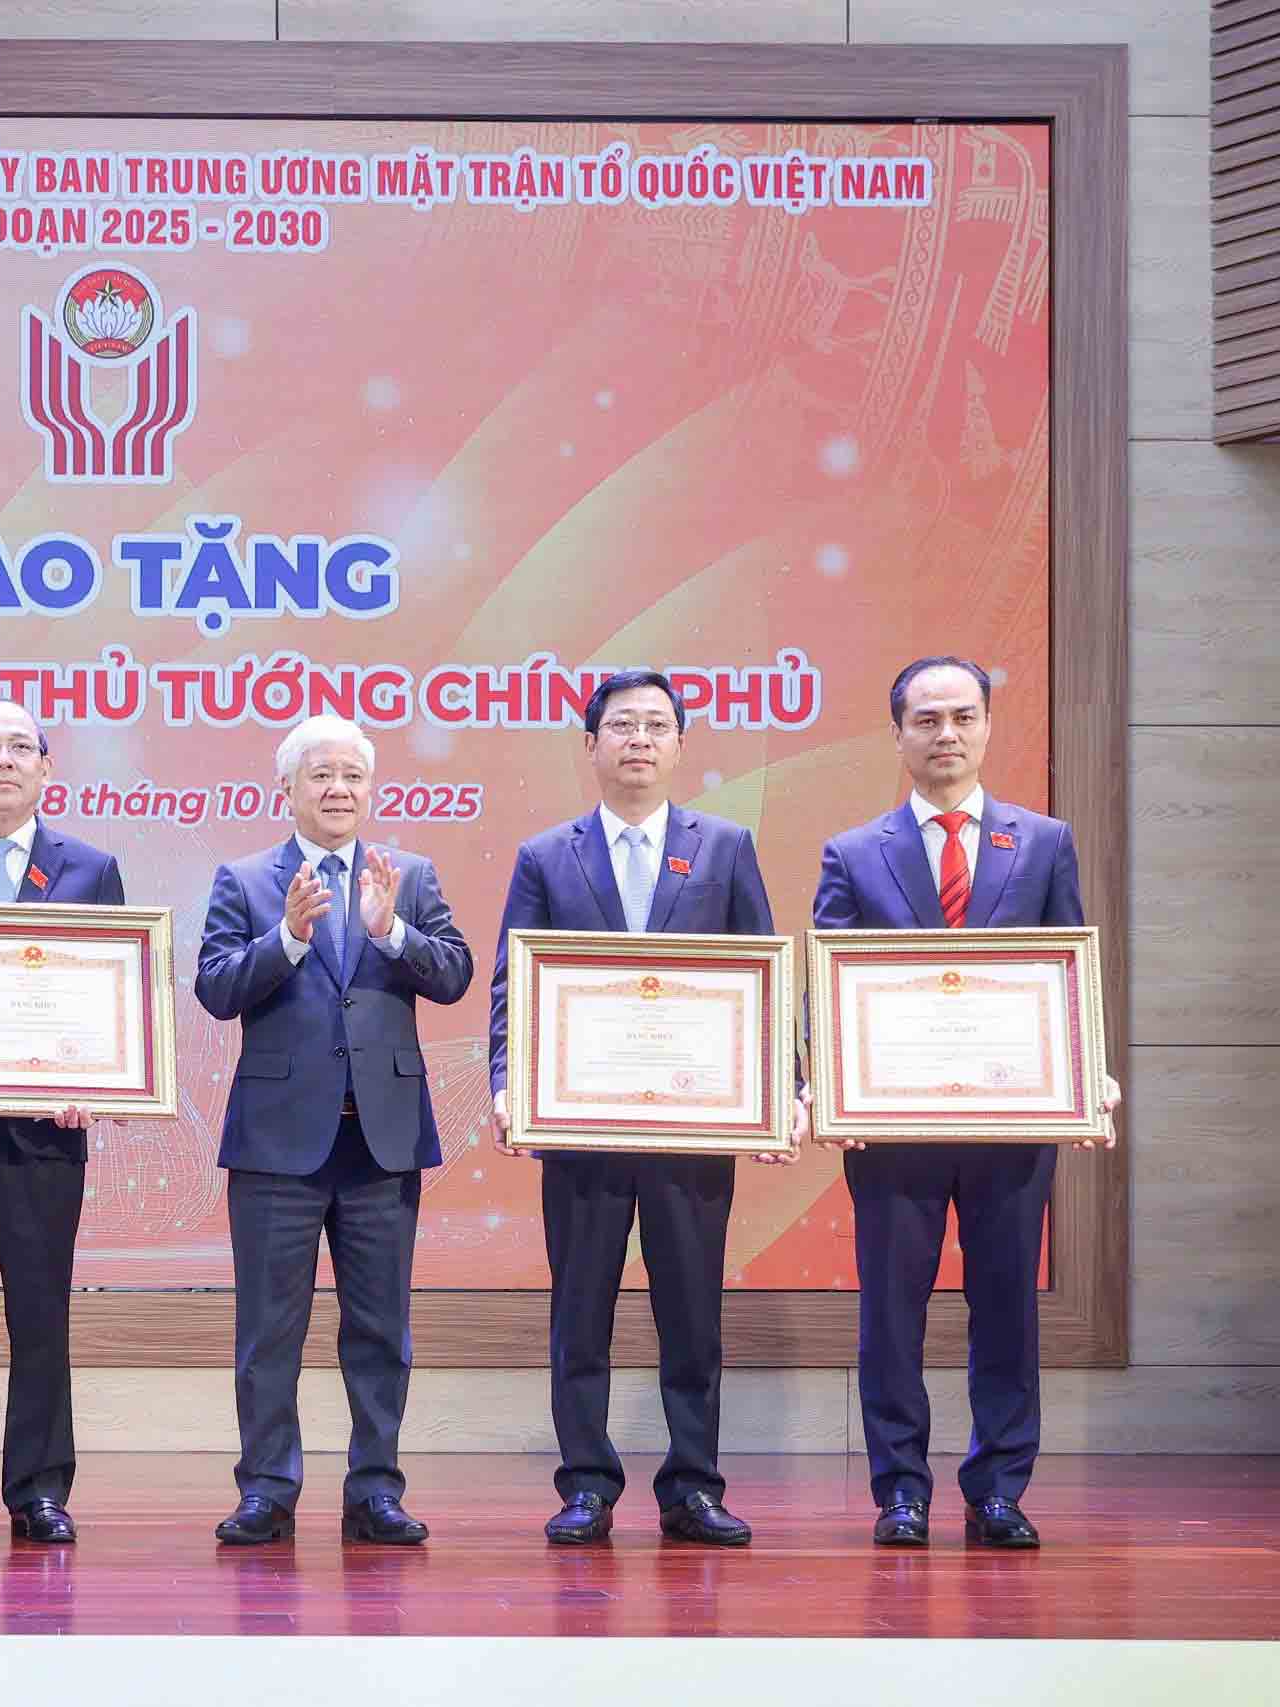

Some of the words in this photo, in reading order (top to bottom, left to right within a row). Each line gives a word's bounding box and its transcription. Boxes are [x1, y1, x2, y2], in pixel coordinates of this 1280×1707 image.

[36, 157, 110, 194] BAN
[125, 158, 246, 194] TRUNG
[261, 156, 361, 195] ƯƠNG
[377, 153, 454, 205] MẶT
[469, 155, 564, 206] TRẬN
[579, 148, 624, 198] TỔ
[638, 151, 734, 201] QUỐC
[750, 157, 827, 207] VIỆT
[842, 164, 926, 199] NAM
[101, 208, 190, 245] 2025
[233, 209, 322, 246] 2030
[120, 521, 391, 630] TẶNG
[158, 656, 406, 722] TƯỚNG
[426, 659, 617, 722] CHÍN
[671, 655, 812, 723] PHỦ
[81, 783, 206, 825] tháng
[221, 786, 260, 817] 10
[380, 786, 479, 818] 2025
